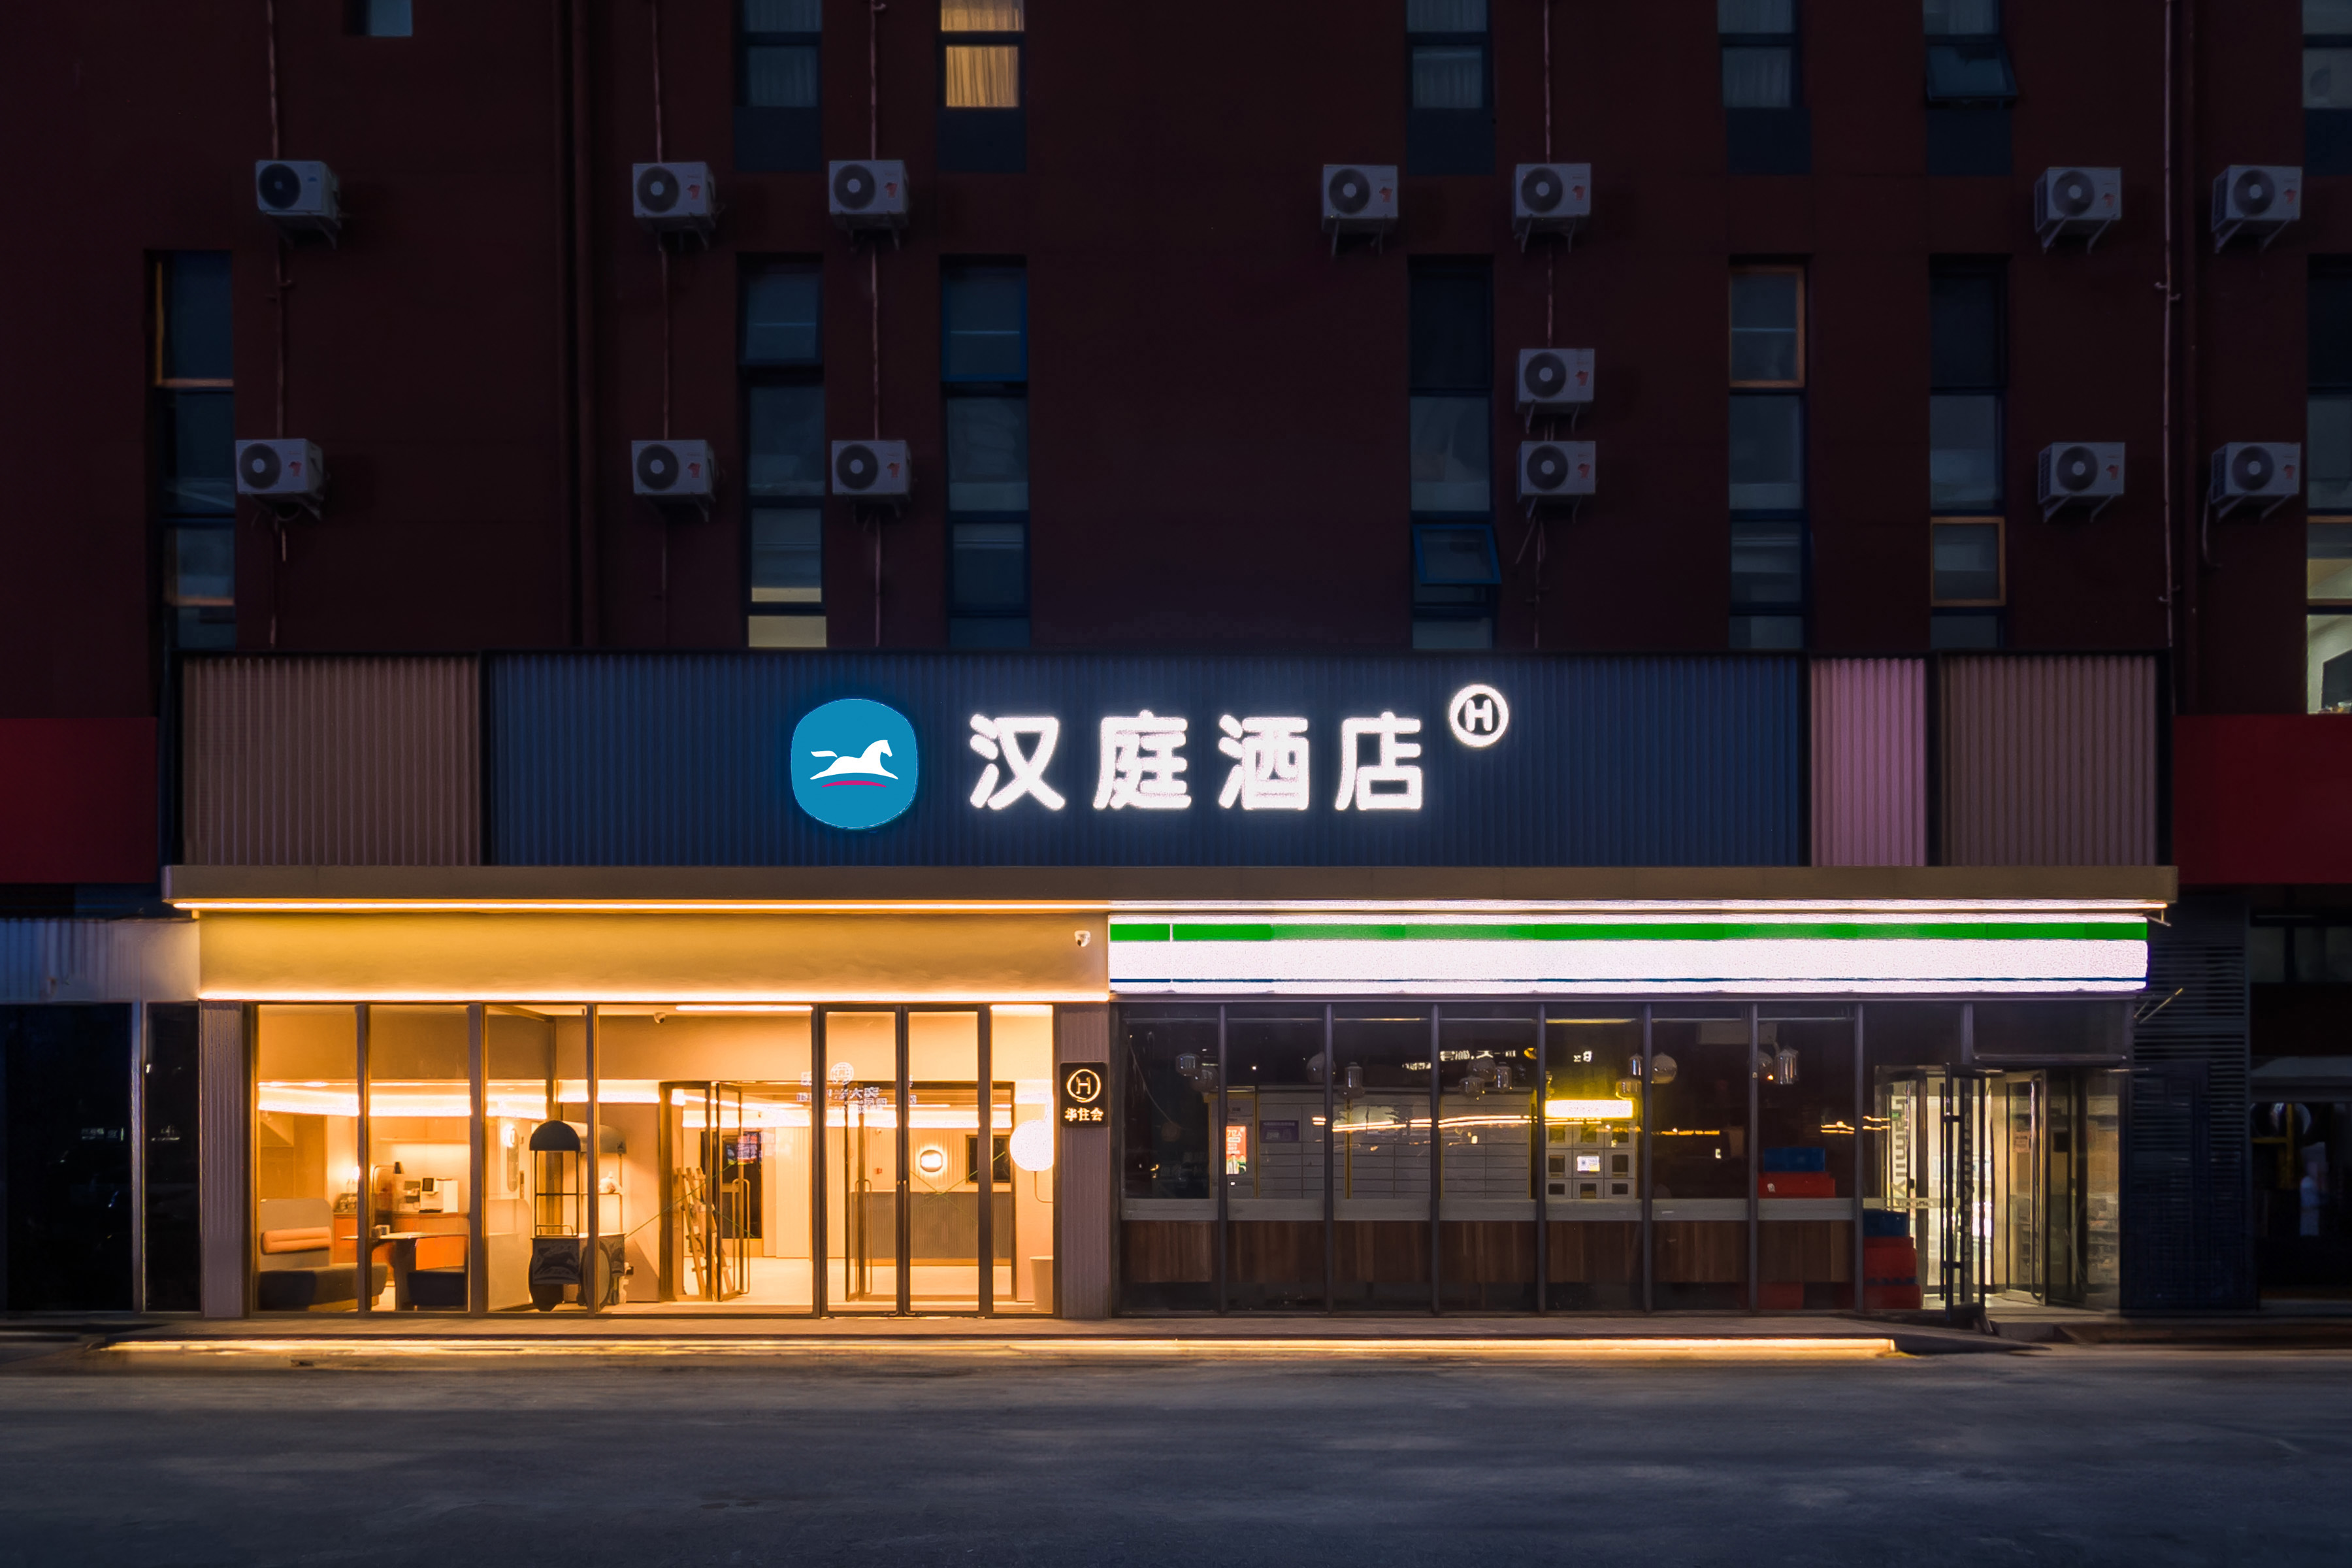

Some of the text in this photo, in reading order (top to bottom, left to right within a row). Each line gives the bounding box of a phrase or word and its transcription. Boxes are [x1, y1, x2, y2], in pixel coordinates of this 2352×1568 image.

[970, 710, 1422, 810] 汉庭酒店
[1064, 1107, 1104, 1122] 华住会
